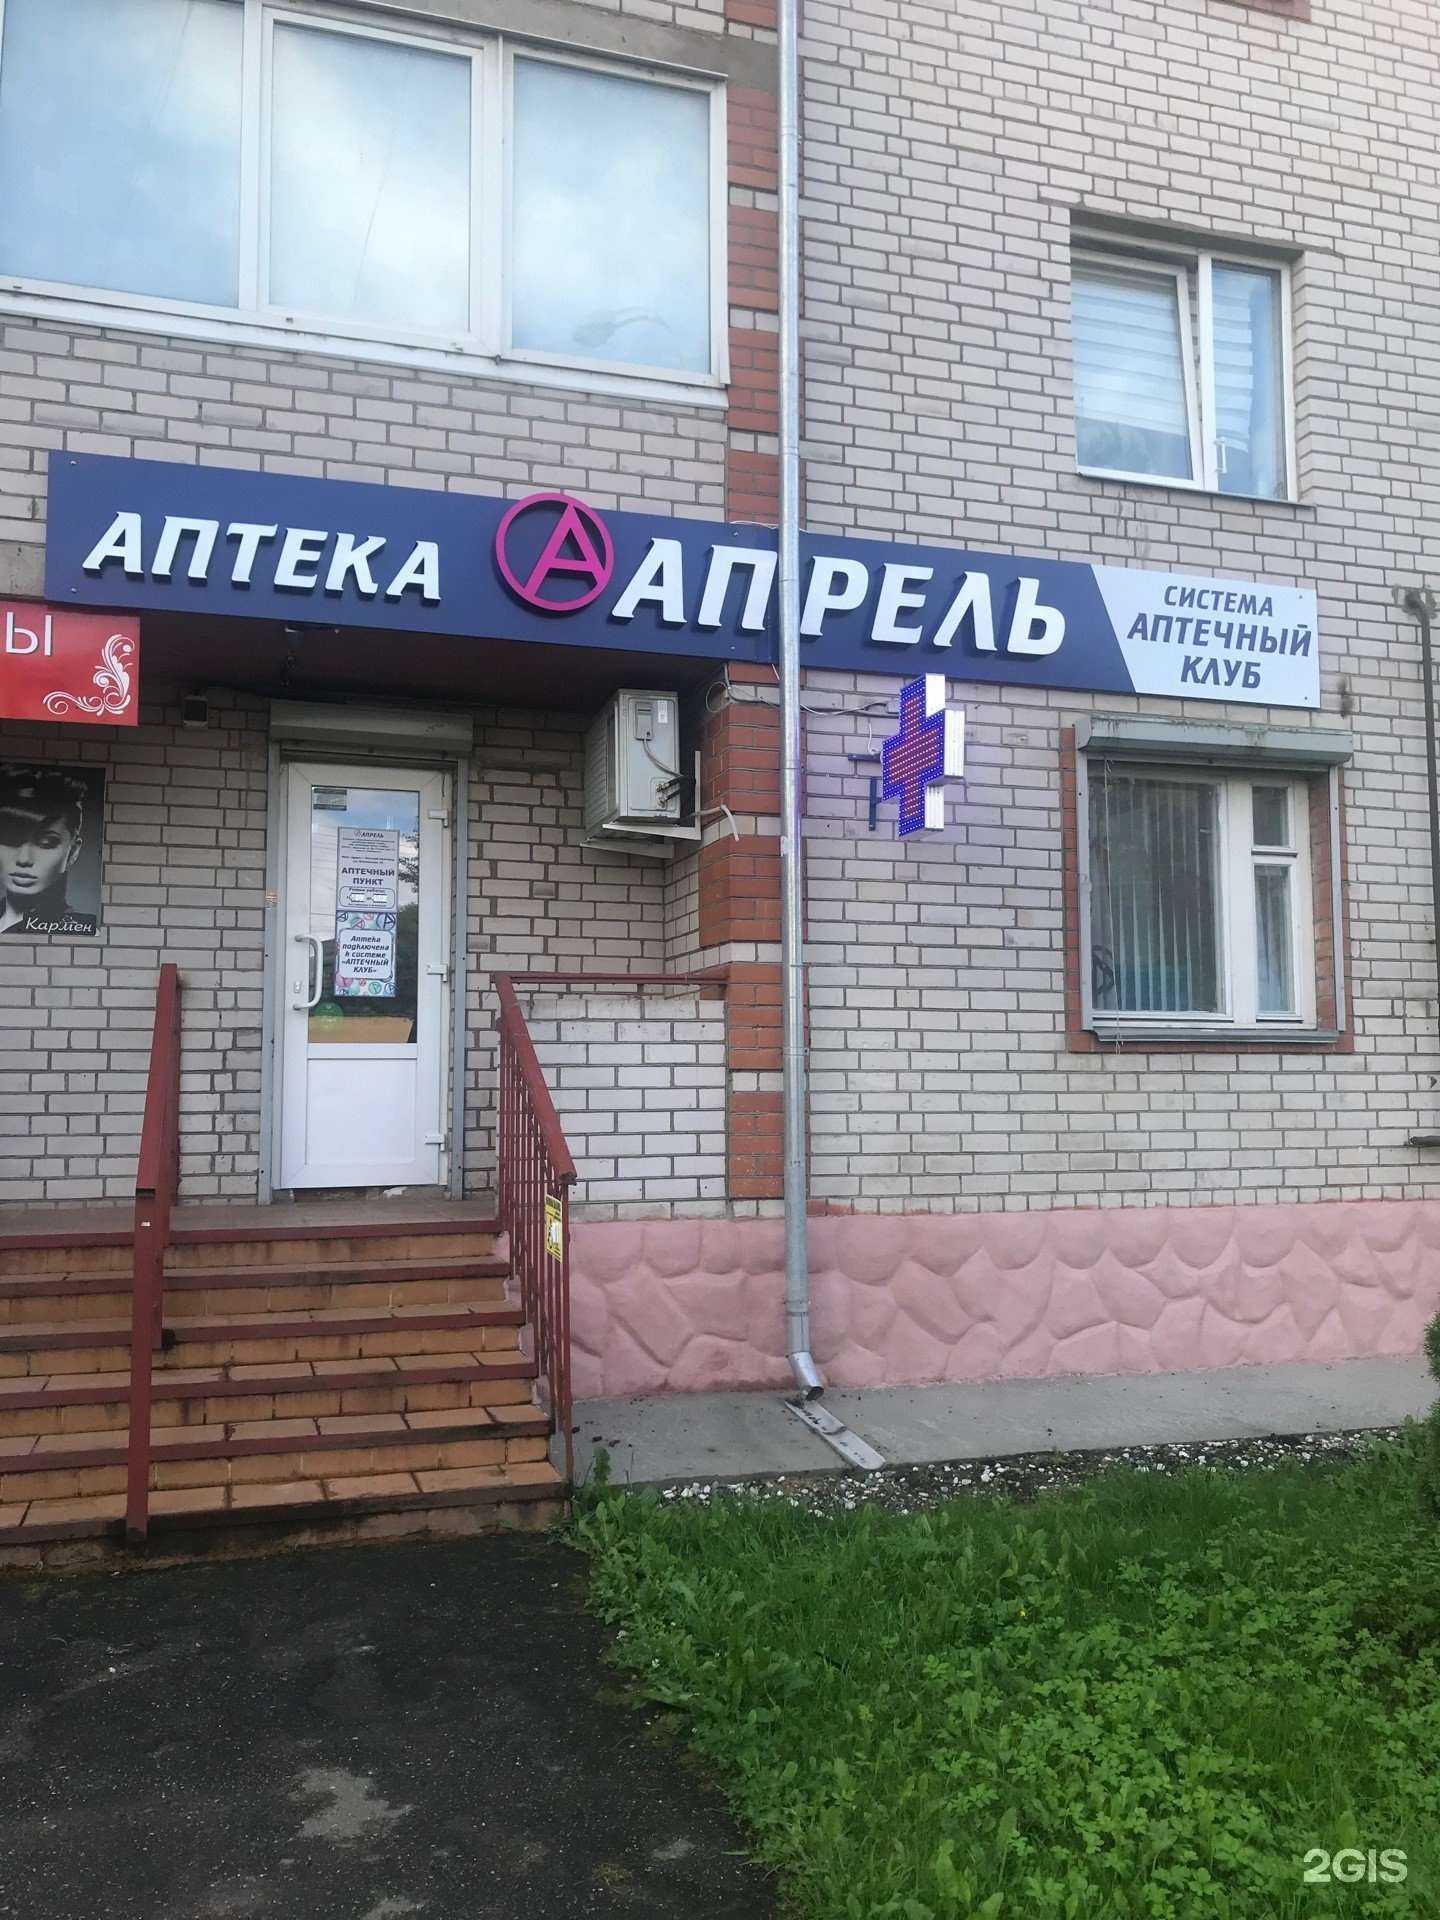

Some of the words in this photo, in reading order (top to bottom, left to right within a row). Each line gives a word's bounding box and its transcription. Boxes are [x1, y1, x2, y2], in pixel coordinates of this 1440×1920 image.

[82, 511, 441, 601] АПТЕКА
[611, 536, 1067, 656] АПРЕЛЬ
[1164, 585, 1273, 617] СИСТЕМА
[1126, 612, 1312, 657] АПТЕЧНЫЙ
[1180, 655, 1262, 689] КЛУБ
[341, 866, 395, 876] АПТЕЧНЫЙ
[353, 877, 384, 885] ПУНКТ
[25, 916, 92, 933] Кармен
[342, 943, 390, 951] подключена
[350, 935, 381, 943] Аптека
